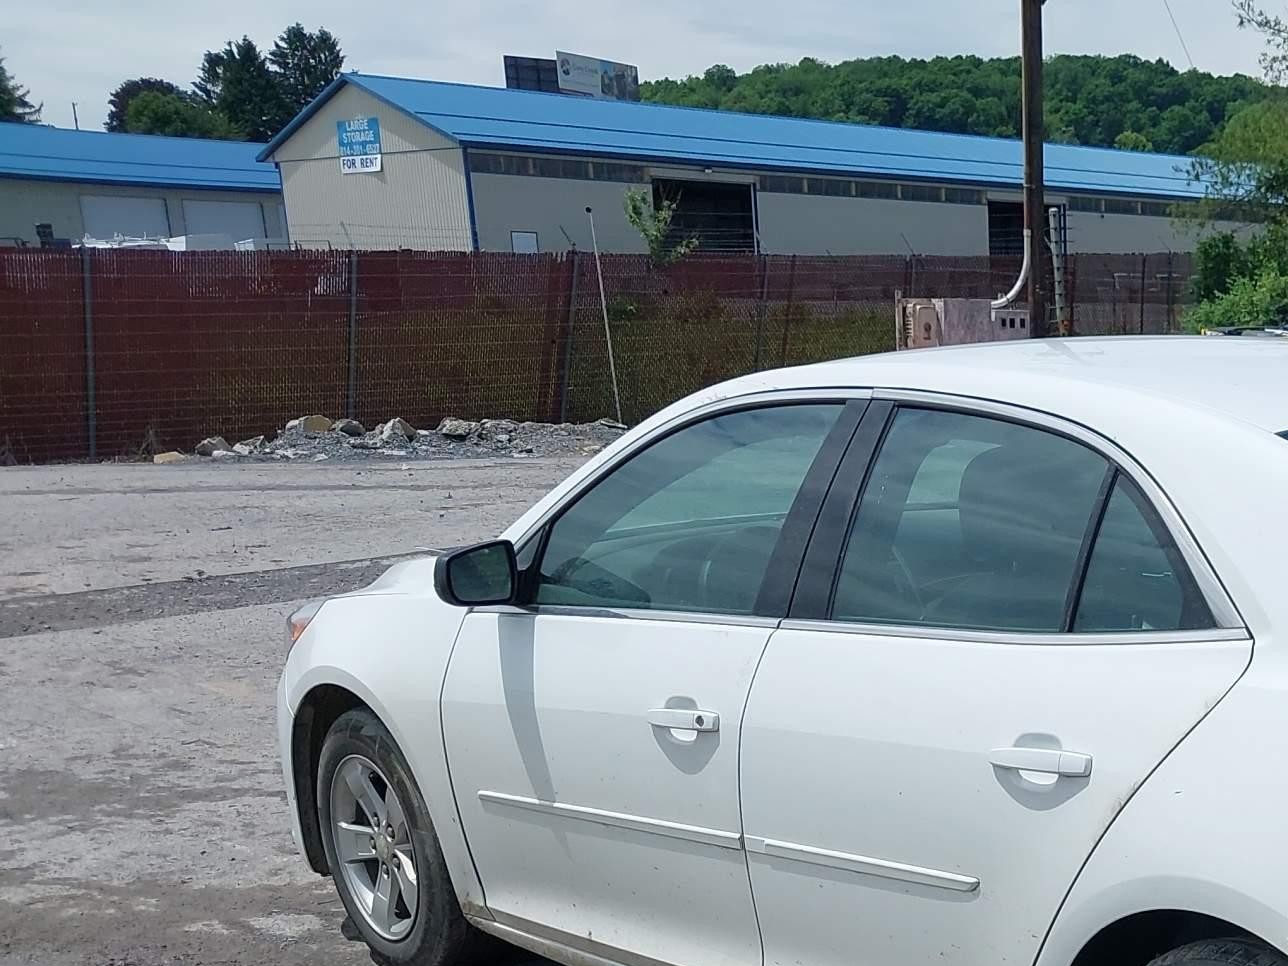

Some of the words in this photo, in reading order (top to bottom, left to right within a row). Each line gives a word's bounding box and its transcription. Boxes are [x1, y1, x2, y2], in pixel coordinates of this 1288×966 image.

[345, 119, 369, 131] LARGE
[342, 130, 375, 143] STORAGE
[342, 158, 357, 169] FOR
[360, 157, 378, 169] RENT
